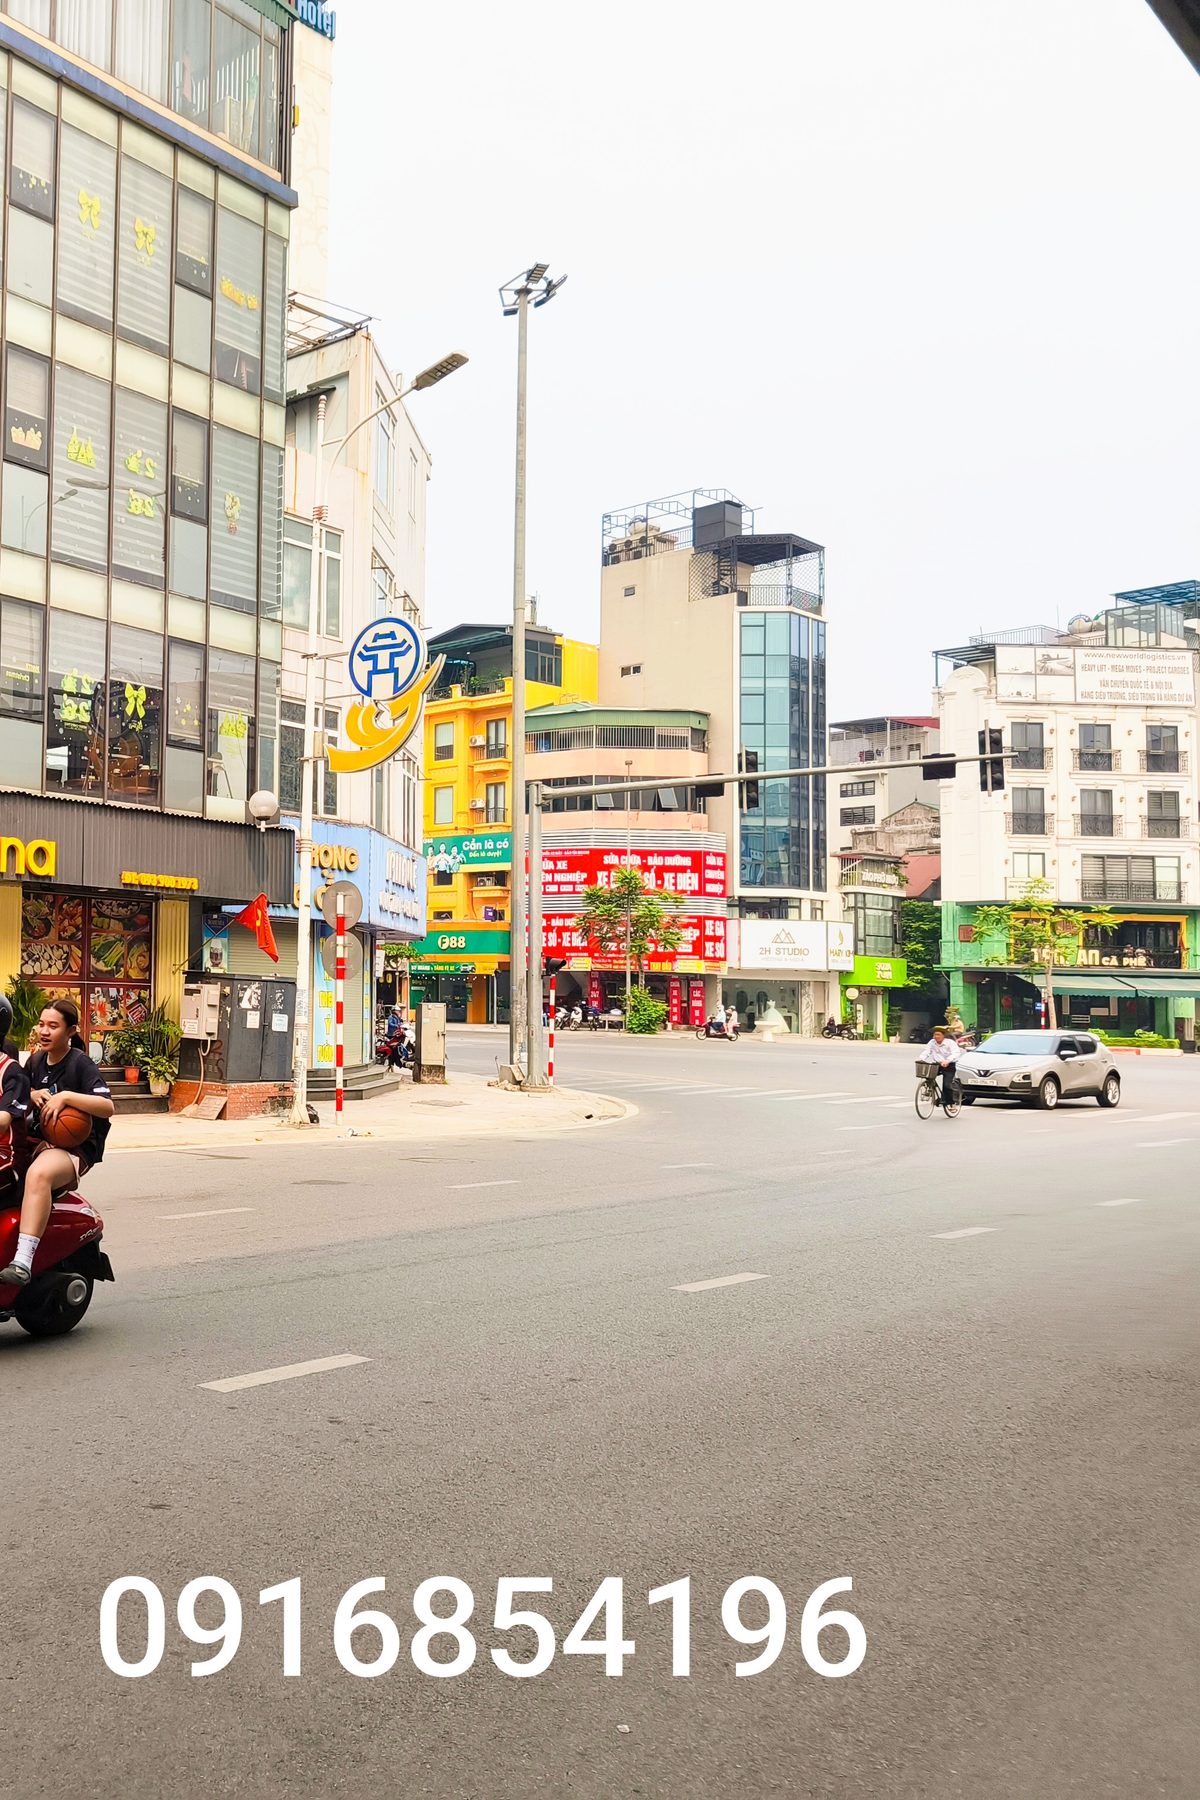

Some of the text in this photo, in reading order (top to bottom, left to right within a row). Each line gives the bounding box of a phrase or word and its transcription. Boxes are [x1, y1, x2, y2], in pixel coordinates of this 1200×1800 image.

[484, 839, 494, 849] là
[496, 837, 509, 849] có
[556, 860, 568, 870] XE
[554, 871, 588, 884] NGHIỆP
[597, 871, 609, 889] XE
[663, 872, 675, 890] XE
[705, 920, 715, 936] XE
[715, 920, 725, 937] GA
[437, 934, 466, 950] F88
[562, 931, 571, 947] XE
[705, 941, 715, 957] XE
[715, 936, 725, 958] SỐ
[759, 947, 809, 956] 2H STUDIO
